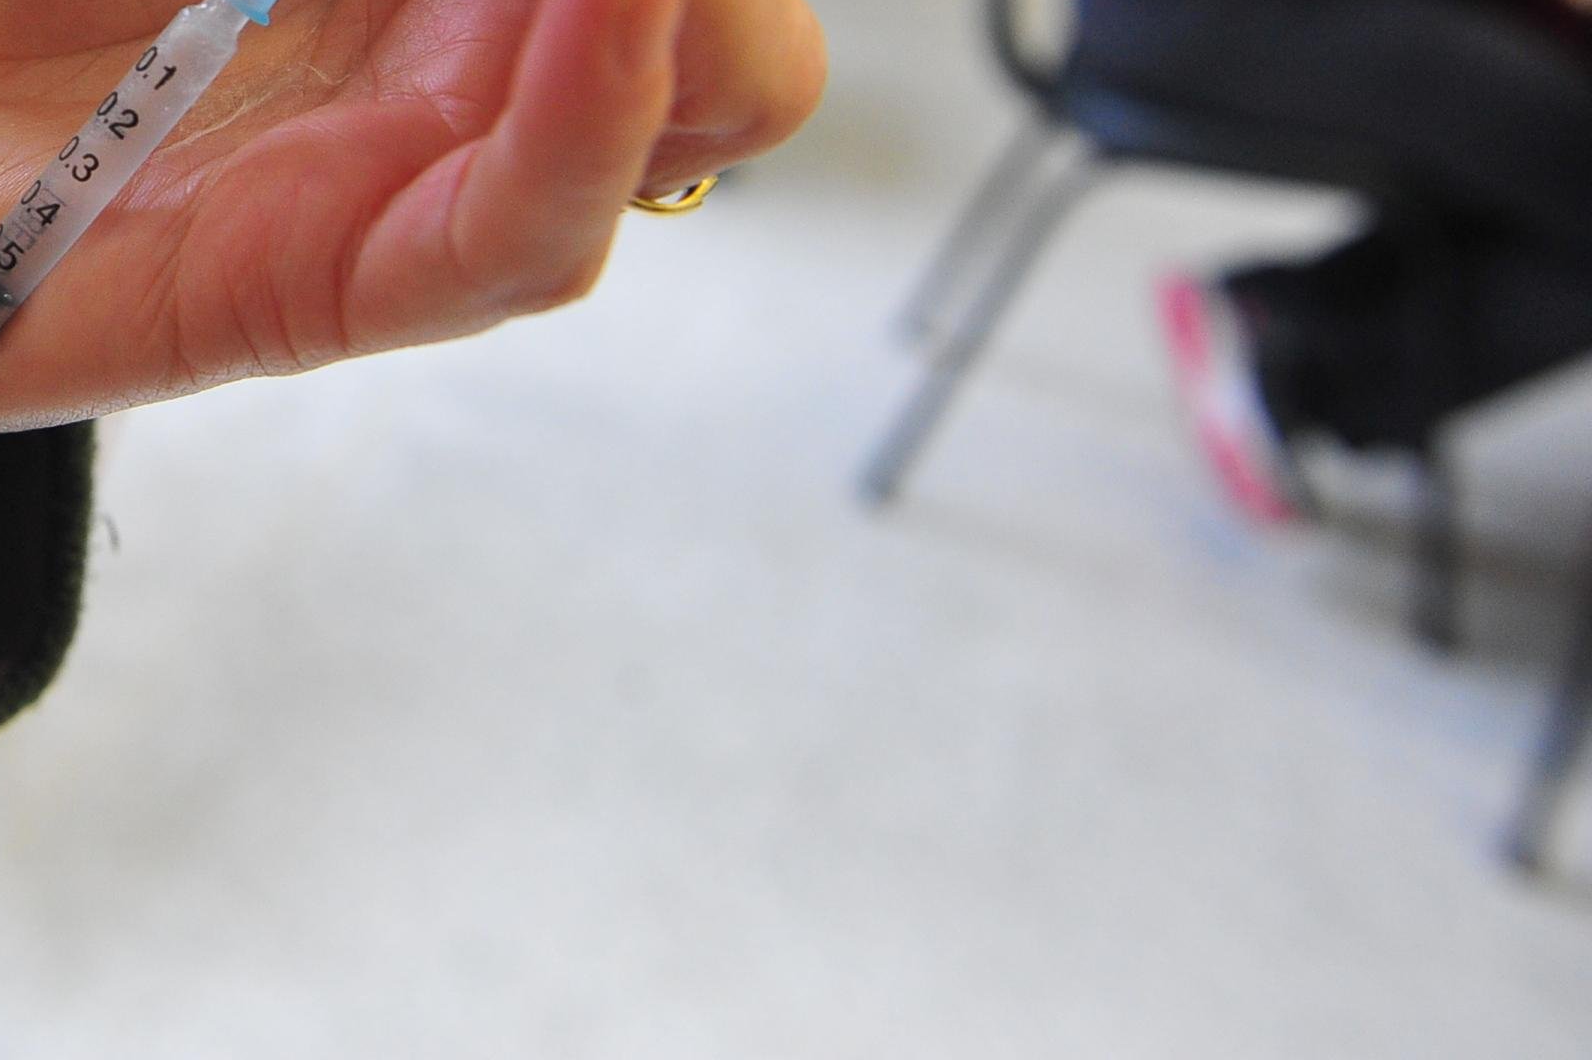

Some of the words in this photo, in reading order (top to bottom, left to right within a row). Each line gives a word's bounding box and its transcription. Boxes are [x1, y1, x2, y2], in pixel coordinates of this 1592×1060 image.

[135, 46, 177, 90] 0.1
[97, 91, 139, 140] 0.2
[59, 135, 99, 182] 0.3
[21, 180, 61, 227] 0.4
